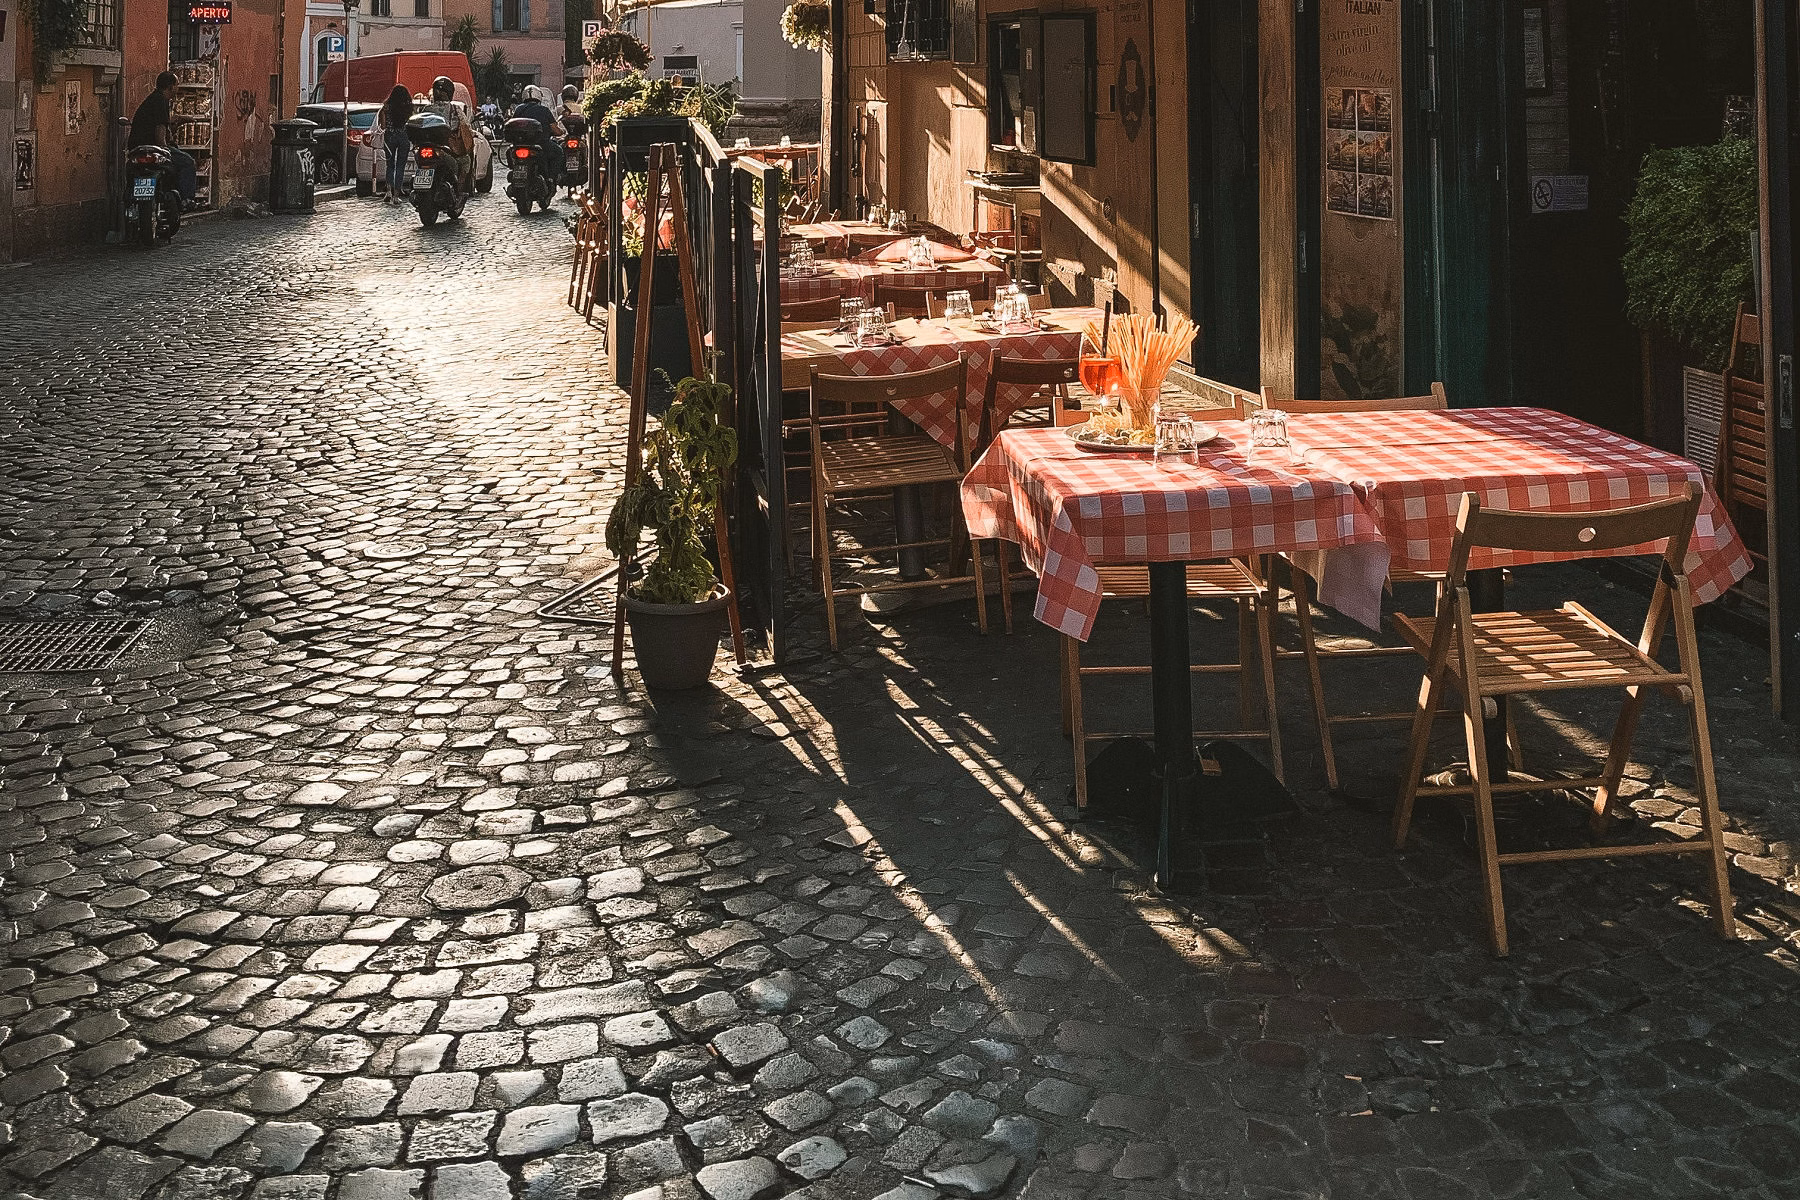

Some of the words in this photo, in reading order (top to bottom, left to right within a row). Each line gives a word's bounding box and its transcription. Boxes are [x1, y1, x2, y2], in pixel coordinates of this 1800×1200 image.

[191, 7, 229, 18] APERTO
[1345, 1, 1381, 15] ITALIAN
[587, 24, 597, 36] P
[1327, 28, 1351, 42] extra
[1352, 22, 1379, 39] virgin
[331, 37, 342, 51] P
[1336, 43, 1358, 57] olive
[1359, 39, 1371, 52] oil
